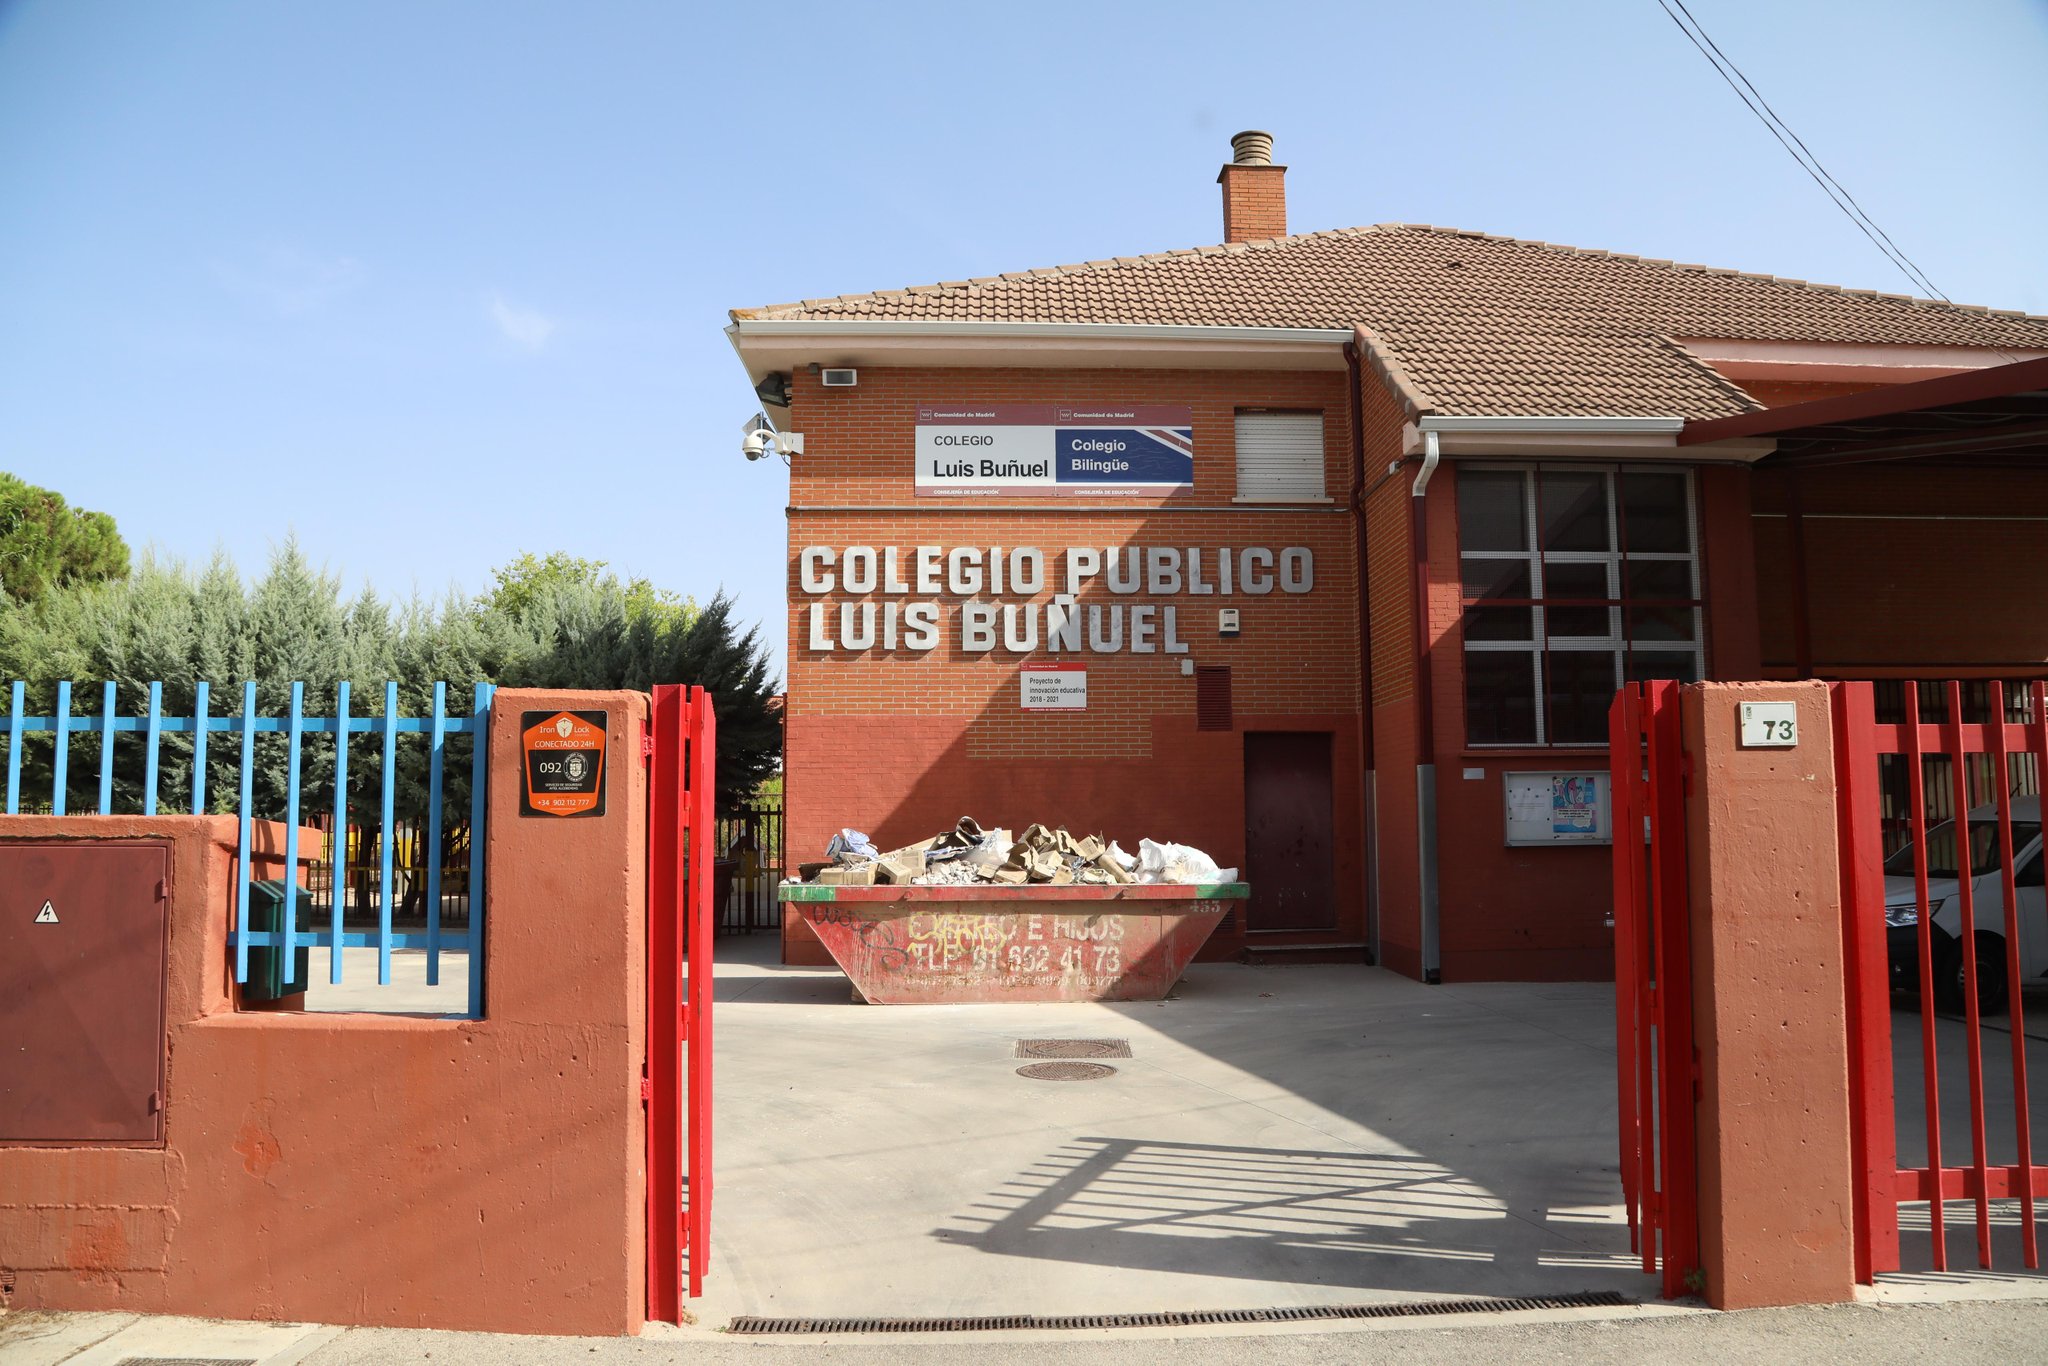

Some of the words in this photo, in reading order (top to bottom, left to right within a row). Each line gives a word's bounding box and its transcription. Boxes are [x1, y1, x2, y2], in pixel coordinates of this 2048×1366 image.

[934, 435, 994, 446] COLEGIO
[1071, 439, 1126, 453] Colegio
[934, 460, 975, 477] Luis
[980, 460, 1048, 477] Buñuel
[1071, 459, 1129, 473] Bilingüe
[801, 546, 1044, 594] COLEGIO
[1067, 546, 1313, 594] PUBLICO
[810, 602, 940, 650] LUIS
[962, 594, 1189, 654] BUÑUEL
[1029, 677, 1053, 685] Proyecto
[1763, 720, 1792, 740] 73
[535, 740, 579, 748] CONECTADO
[581, 740, 594, 748] 24H
[540, 762, 562, 773] 092
[1028, 913, 1043, 940] E
[1053, 913, 1125, 940] HIJOS
[1060, 945, 1083, 971] 41
[1093, 945, 1120, 972] 73
